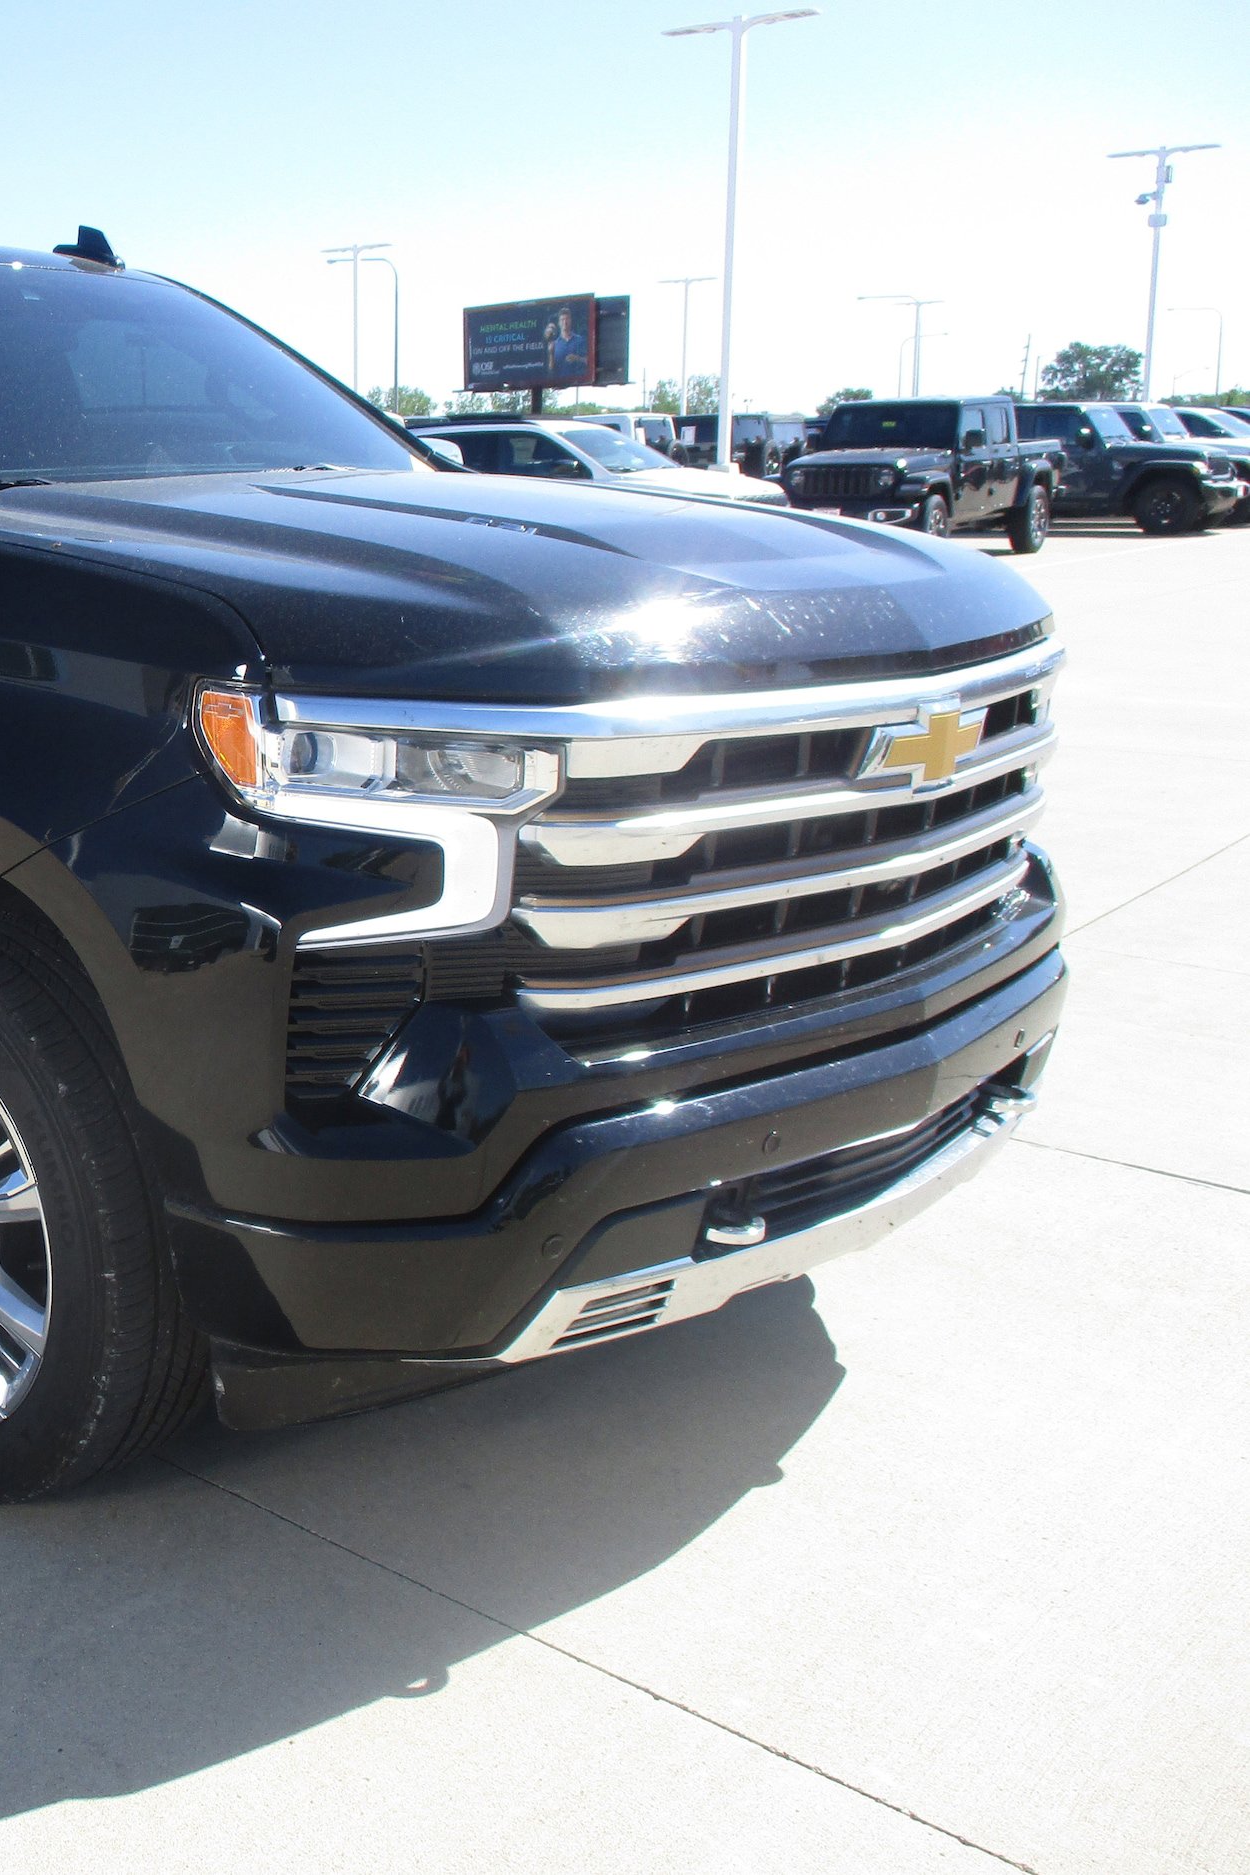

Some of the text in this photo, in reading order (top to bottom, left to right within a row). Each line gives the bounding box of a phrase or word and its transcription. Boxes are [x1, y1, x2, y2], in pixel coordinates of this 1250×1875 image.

[480, 320, 537, 333] MENTAL HEALTH
[486, 334, 525, 344] IS CRITICAL
[484, 346, 498, 354] AND
[499, 345, 510, 353] OFF
[513, 344, 524, 352] THE
